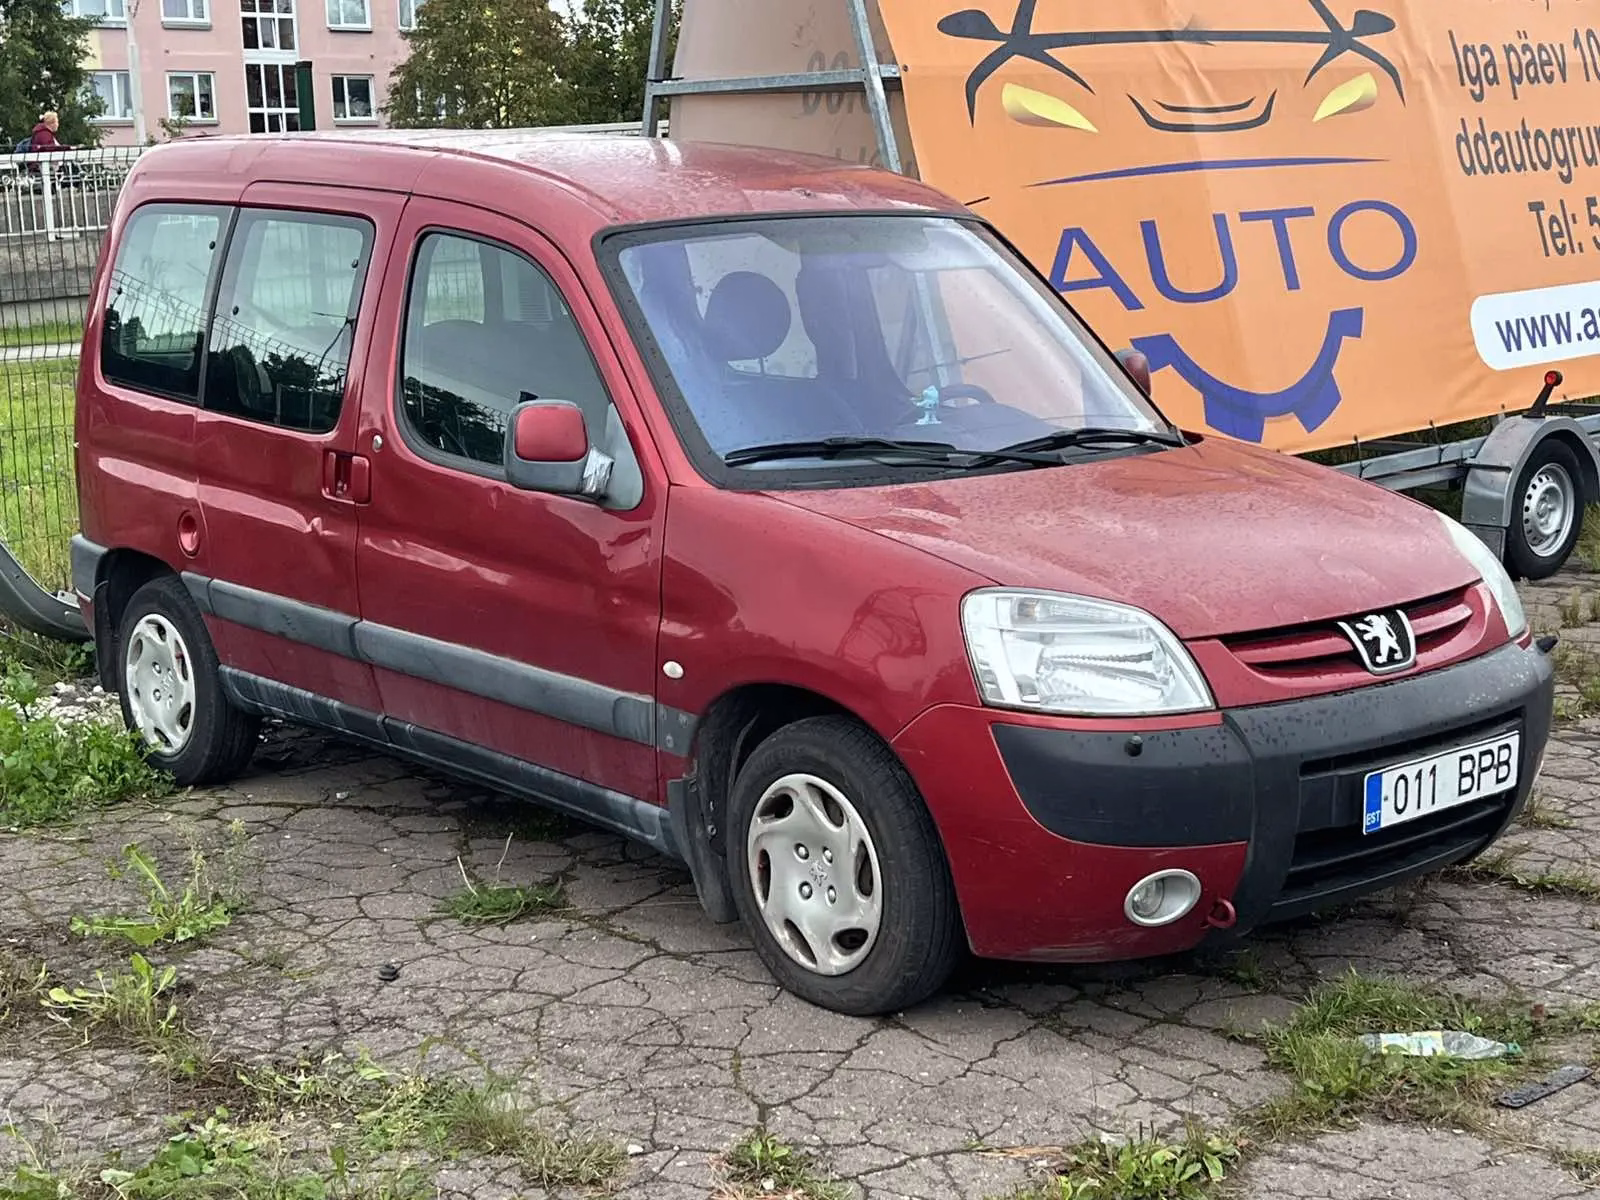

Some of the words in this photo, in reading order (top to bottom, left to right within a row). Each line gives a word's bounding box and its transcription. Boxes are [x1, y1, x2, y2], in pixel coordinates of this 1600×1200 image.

[1448, 29, 1500, 102] Iga
[1502, 29, 1567, 100] päev
[1456, 116, 1600, 184] ddautogru
[1048, 199, 1418, 311] AUTO
[1528, 198, 1584, 257] Tel:
[1495, 308, 1600, 352] www.a
[1394, 764, 1437, 815] 011
[1458, 743, 1512, 797] BPB
[1366, 810, 1381, 826] EST
